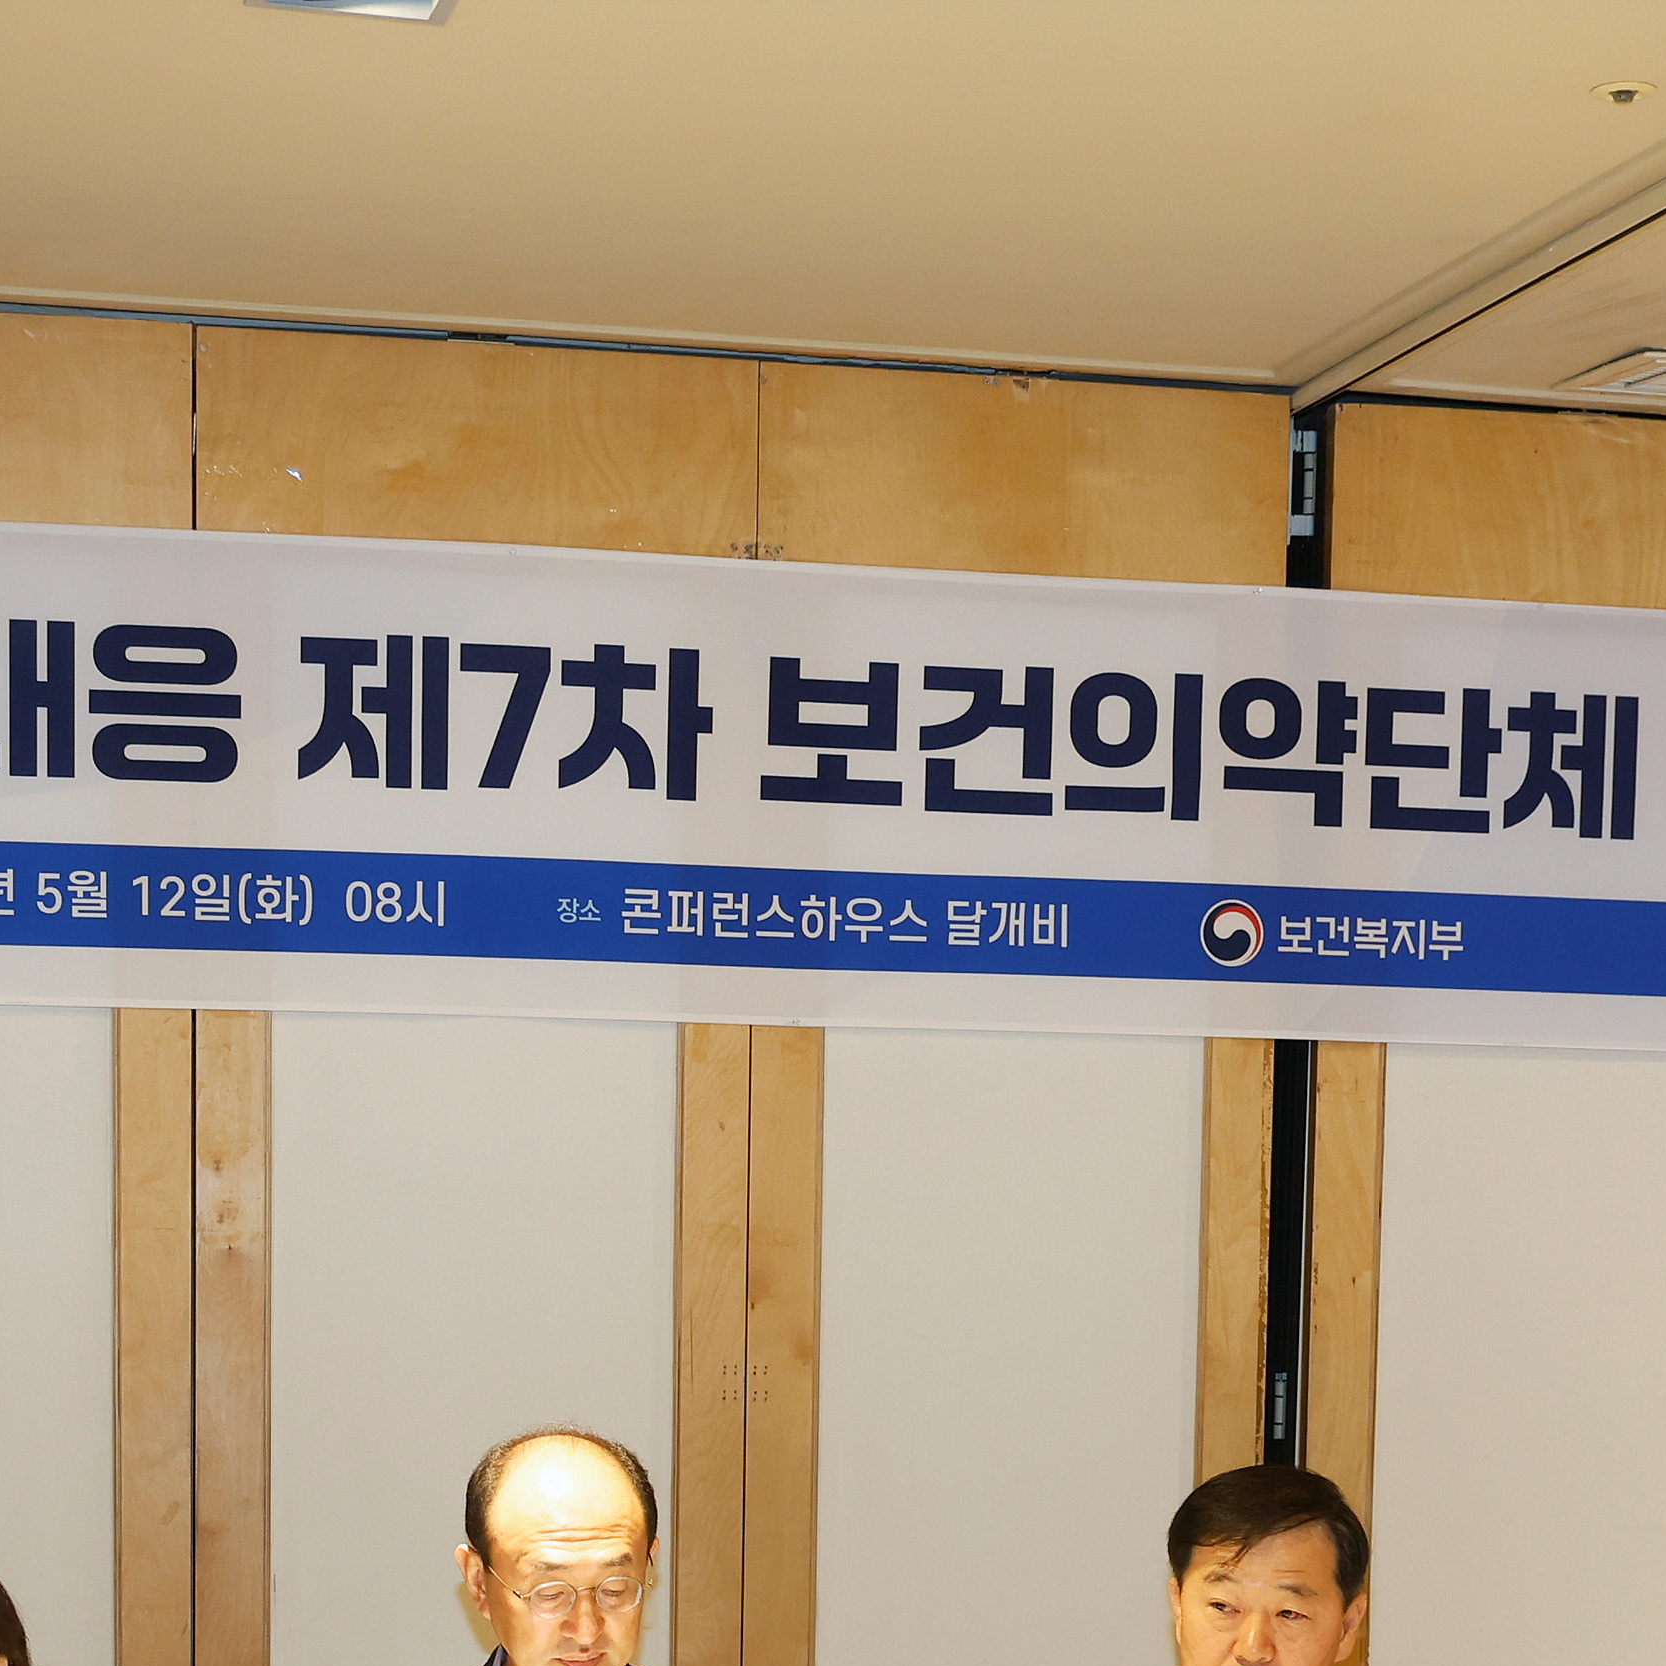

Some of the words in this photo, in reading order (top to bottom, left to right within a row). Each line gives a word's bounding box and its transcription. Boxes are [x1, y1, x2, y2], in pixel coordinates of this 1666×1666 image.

[298, 635, 713, 801] 제7차
[760, 657, 1638, 840] 보건의약단체
[37, 871, 107, 918] 5월
[133, 873, 312, 925] 12일(화)
[346, 881, 444, 926] 08시
[557, 898, 601, 922] 장소
[622, 889, 927, 942] 콘퍼런스하우스
[948, 901, 1067, 947] 달개비
[1278, 916, 1463, 960] 보건복지부
